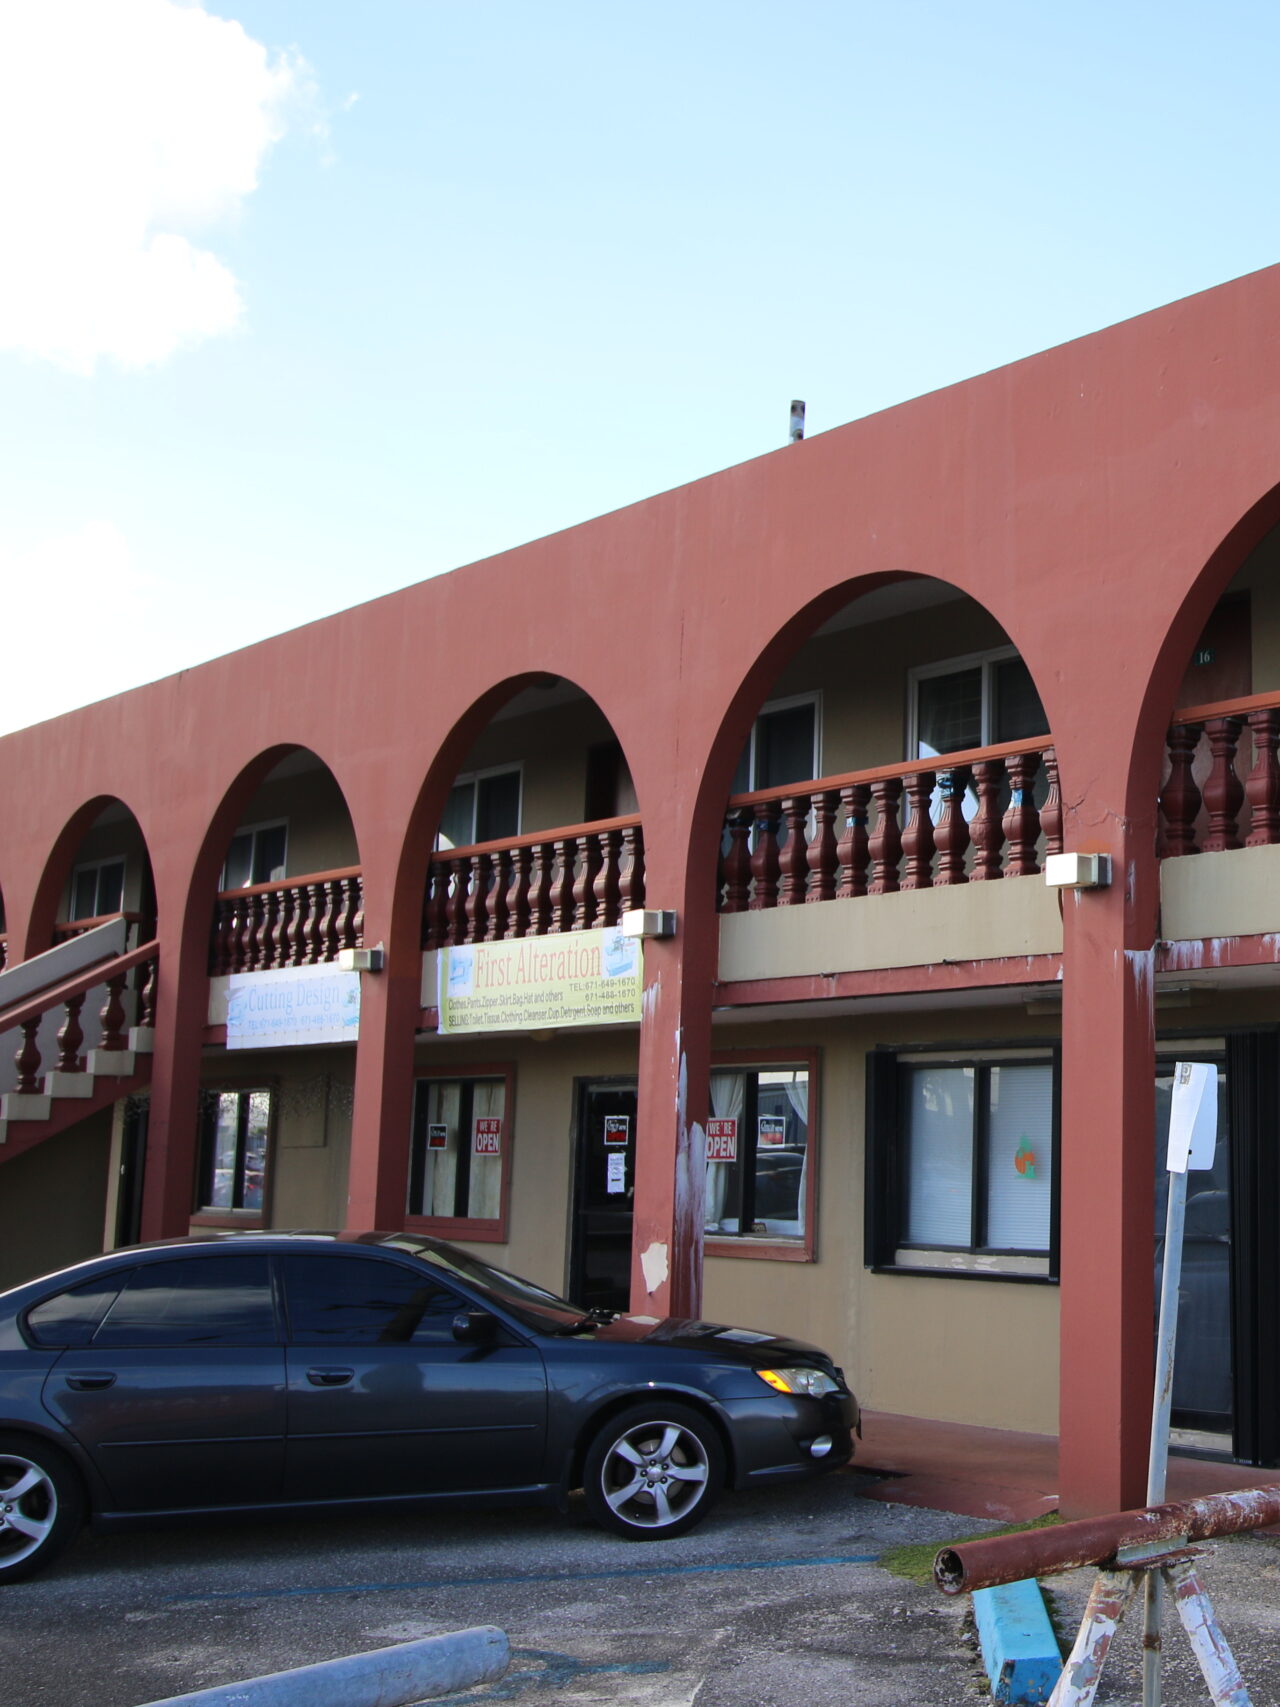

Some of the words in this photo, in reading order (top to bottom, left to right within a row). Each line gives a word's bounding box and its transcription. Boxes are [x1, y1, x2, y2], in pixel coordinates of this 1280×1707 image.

[475, 949, 512, 988] First
[515, 939, 602, 985] Alteration
[249, 988, 293, 1016] Cutting
[297, 983, 340, 1011] Design
[615, 1001, 635, 1014] others
[480, 1120, 498, 1132] WE'RE
[708, 1121, 732, 1135] WE'RE
[477, 1133, 499, 1151] OPEN
[706, 1136, 735, 1157] OPEN
